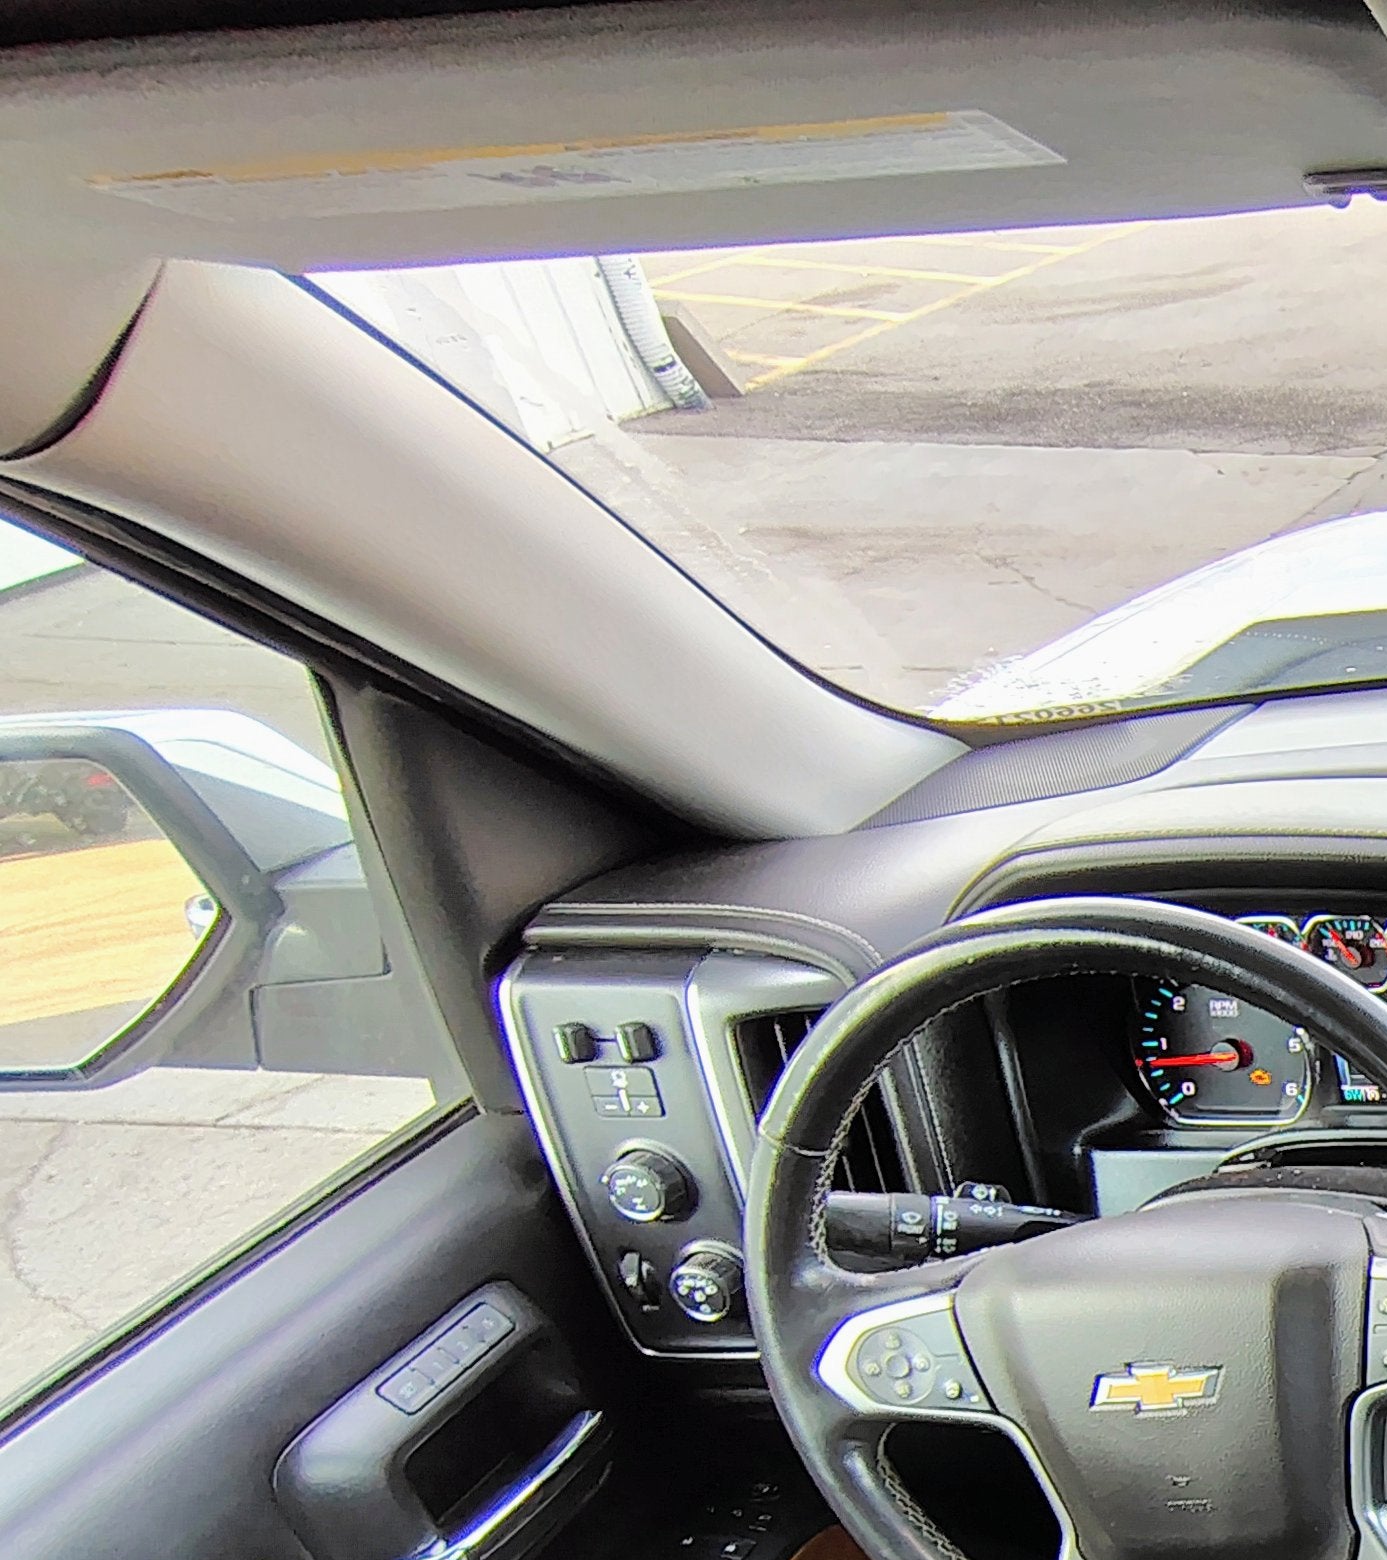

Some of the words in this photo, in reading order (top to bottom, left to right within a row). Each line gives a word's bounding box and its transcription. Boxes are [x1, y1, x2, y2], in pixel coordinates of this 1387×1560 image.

[1172, 996, 1185, 1011] 2
[1209, 1000, 1238, 1010] RPM
[1160, 1037, 1167, 1050] 1
[1289, 1037, 1302, 1053] 5
[1182, 1081, 1196, 1096] 0
[1285, 1082, 1298, 1096] 6
